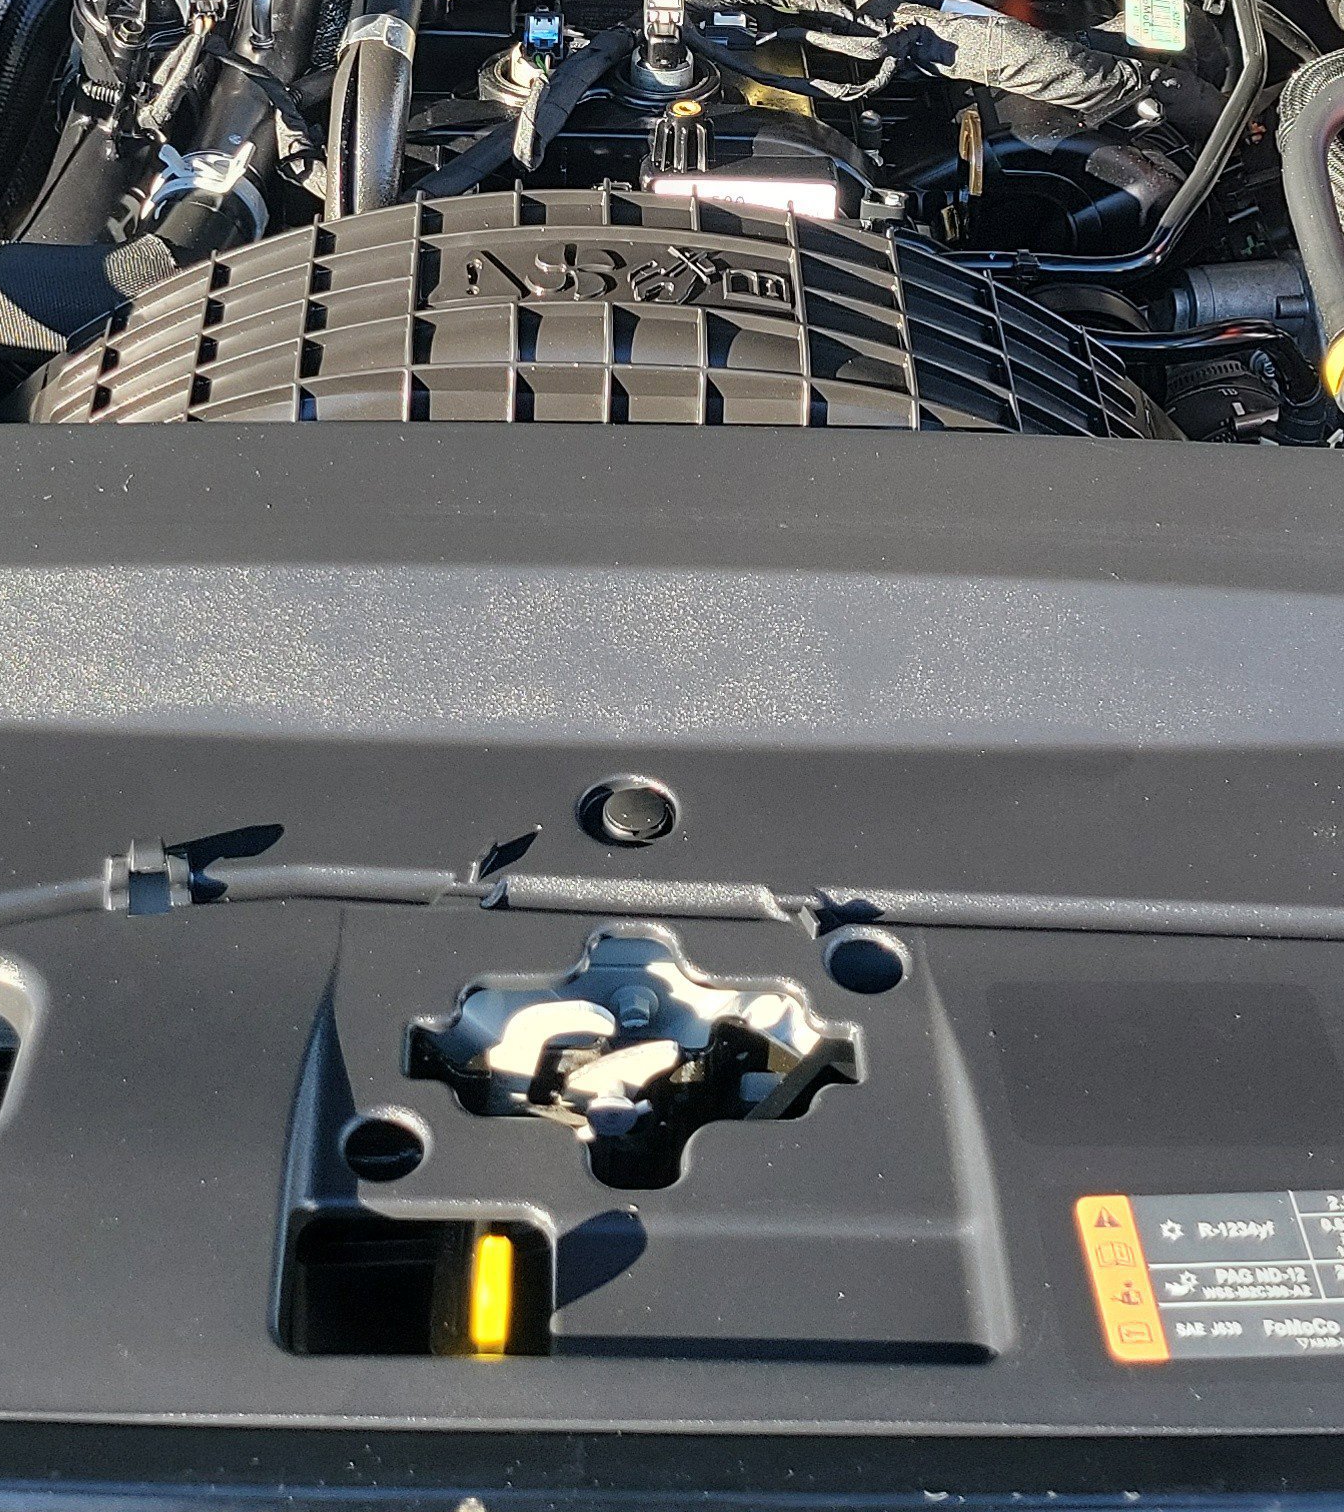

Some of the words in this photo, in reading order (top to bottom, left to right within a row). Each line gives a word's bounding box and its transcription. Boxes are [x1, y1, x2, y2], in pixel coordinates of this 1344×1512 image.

[1197, 1221, 1275, 1240] R-1234yf
[1215, 1268, 1254, 1284] PAG
[1255, 1267, 1308, 1284] ND-12
[1176, 1322, 1207, 1337] SAE
[1262, 1317, 1341, 1337] FoMoCo
